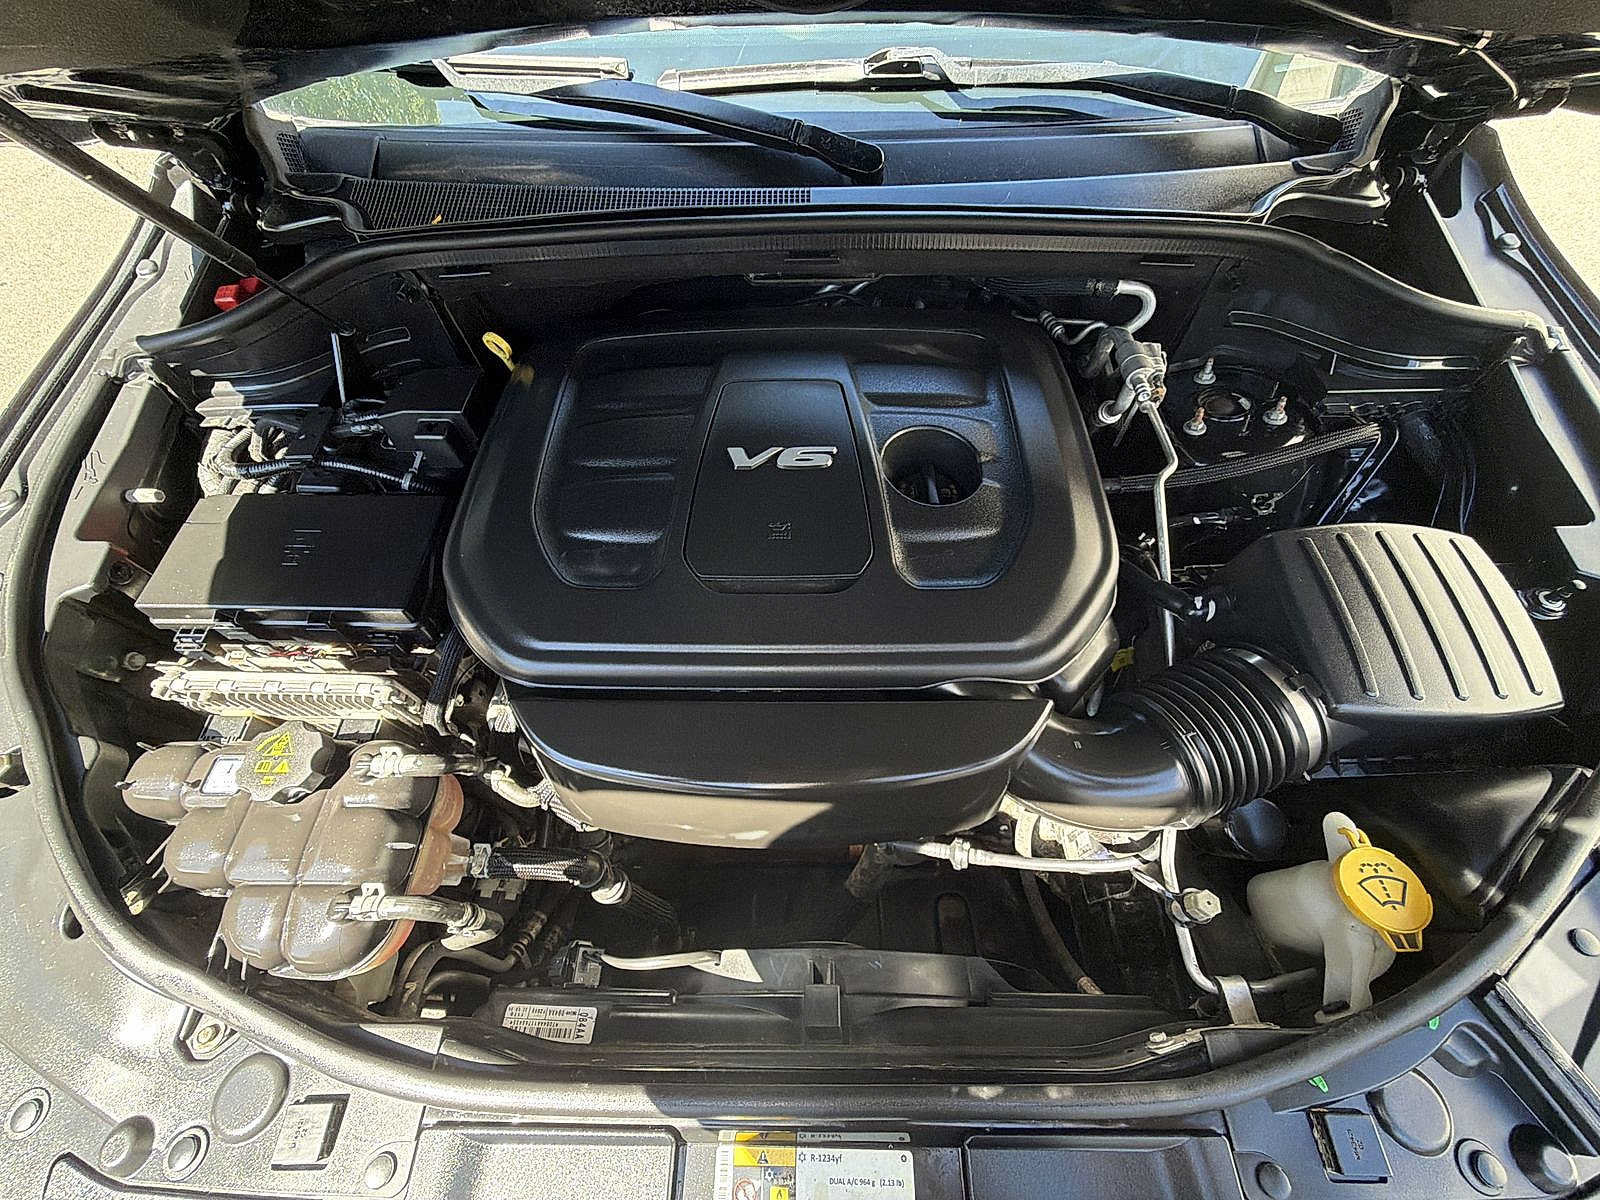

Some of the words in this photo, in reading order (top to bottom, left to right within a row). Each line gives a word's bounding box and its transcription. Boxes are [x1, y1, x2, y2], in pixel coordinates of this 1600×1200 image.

[727, 446, 838, 470] V6
[810, 1153, 842, 1164] R-1234yf
[829, 1177, 846, 1186] DUAL
[847, 1177, 859, 1186] A/C
